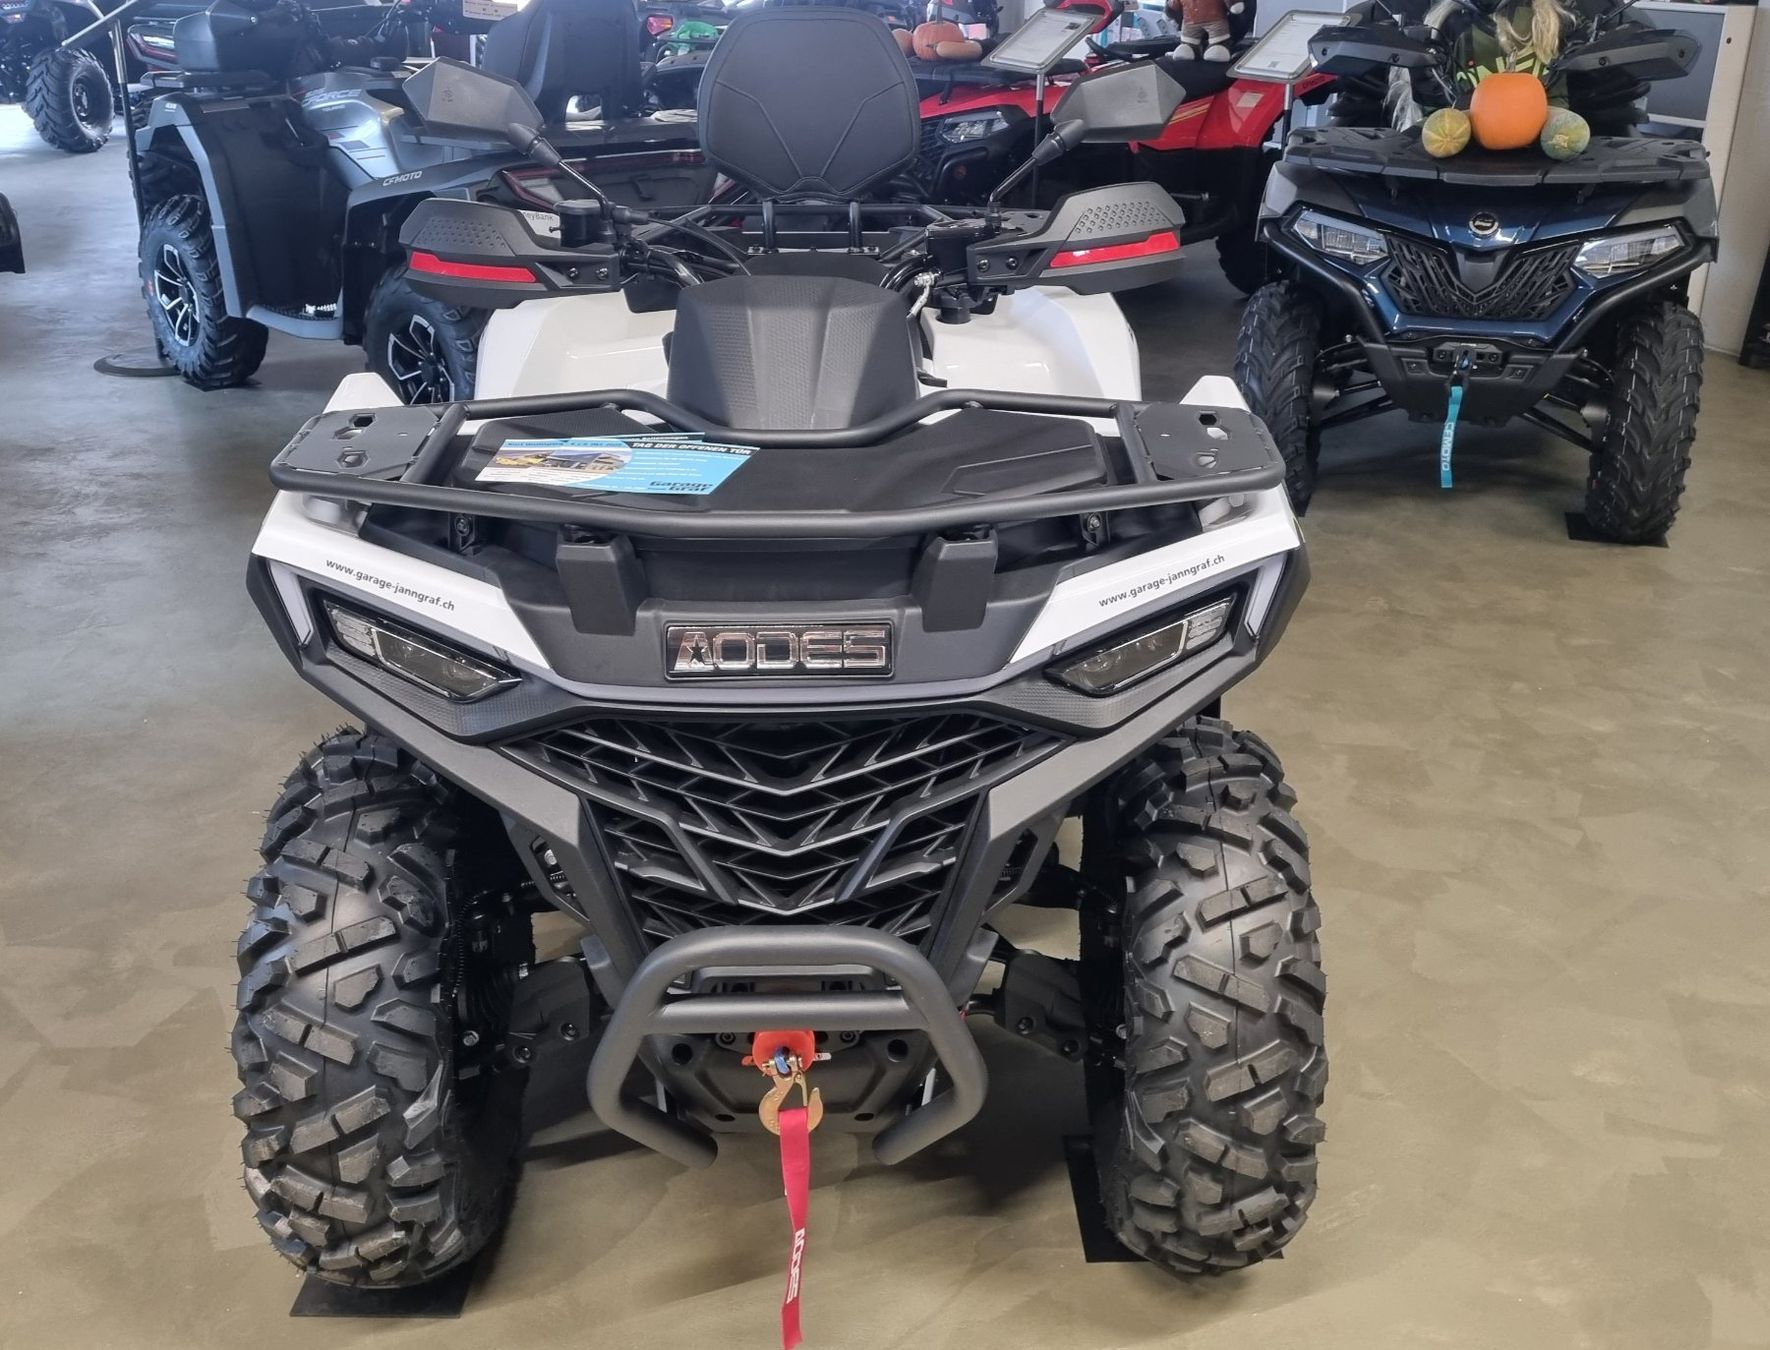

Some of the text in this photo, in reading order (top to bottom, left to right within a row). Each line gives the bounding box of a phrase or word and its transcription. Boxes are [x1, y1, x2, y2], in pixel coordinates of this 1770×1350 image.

[382, 170, 423, 187] CFMOTO
[631, 441, 653, 449] TAG
[678, 444, 728, 453] OFFENEN
[730, 446, 753, 456] TÜR
[1440, 421, 1455, 471] CFMOTO
[325, 559, 456, 611] www.garage-janngraf.ch
[1098, 554, 1226, 607] www.garage-janngraf.ch
[673, 631, 887, 672] AODES
[785, 1227, 806, 1305] AODES
